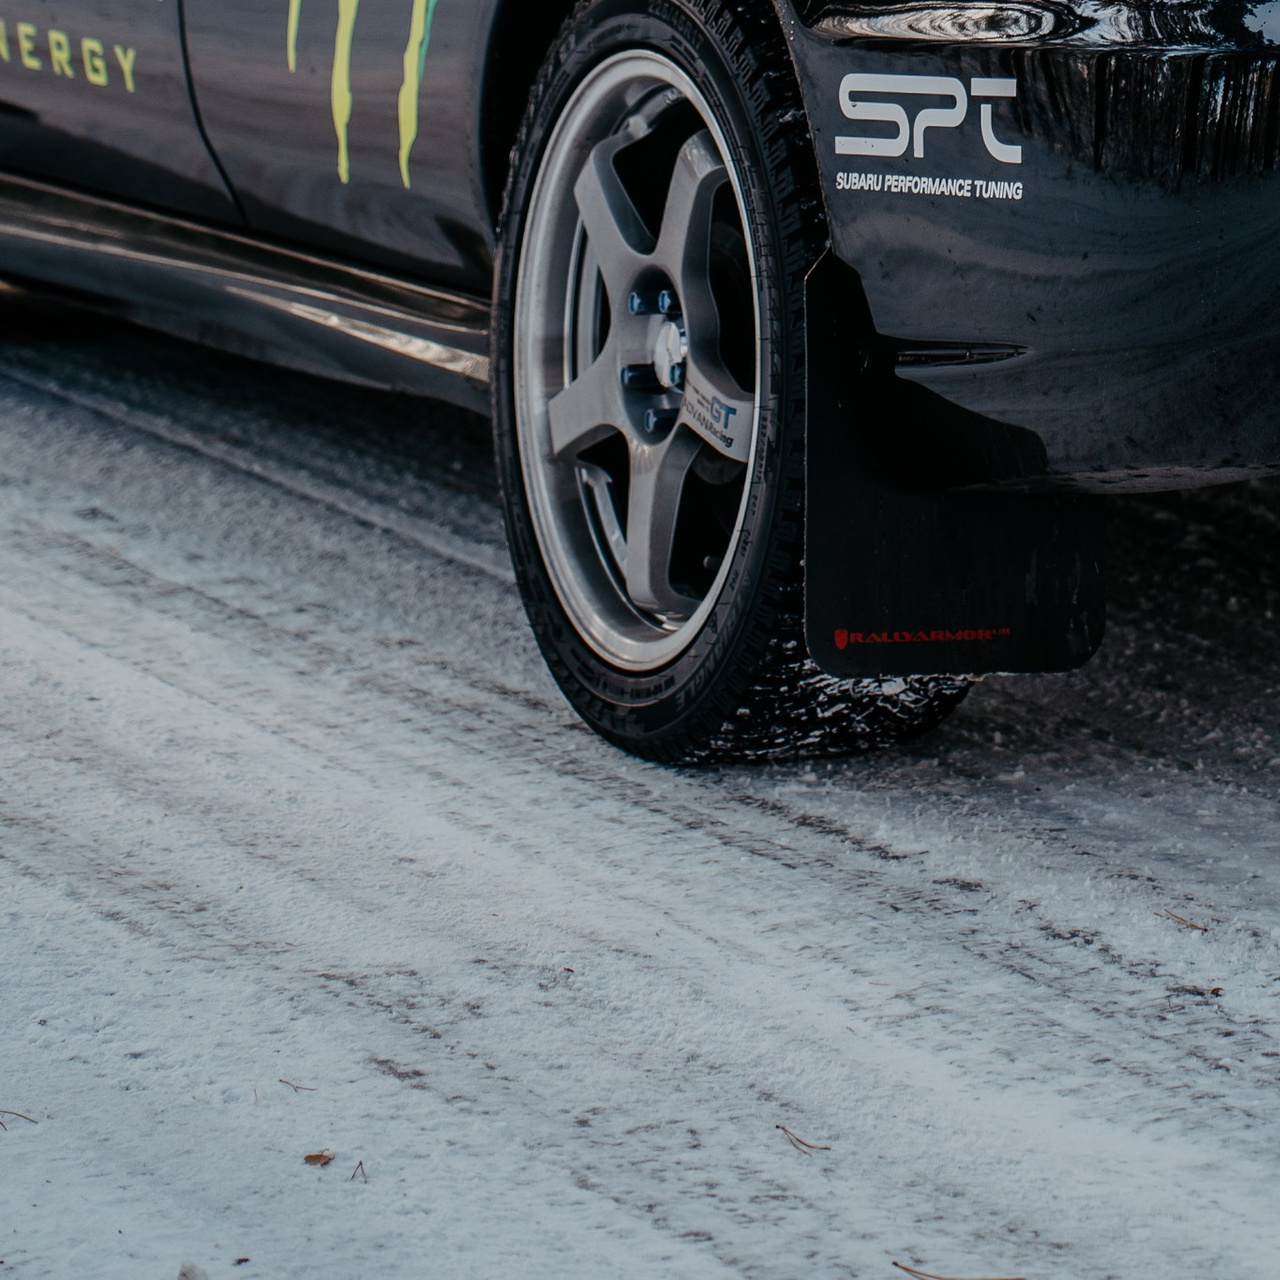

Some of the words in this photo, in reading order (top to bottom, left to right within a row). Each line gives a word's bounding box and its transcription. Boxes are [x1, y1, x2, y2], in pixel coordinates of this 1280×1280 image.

[835, 74, 1022, 164] SPT
[836, 171, 882, 191] SUBARU
[884, 174, 972, 197] PERFORMANCE
[974, 180, 1023, 200] TUNING
[710, 395, 737, 430] GT
